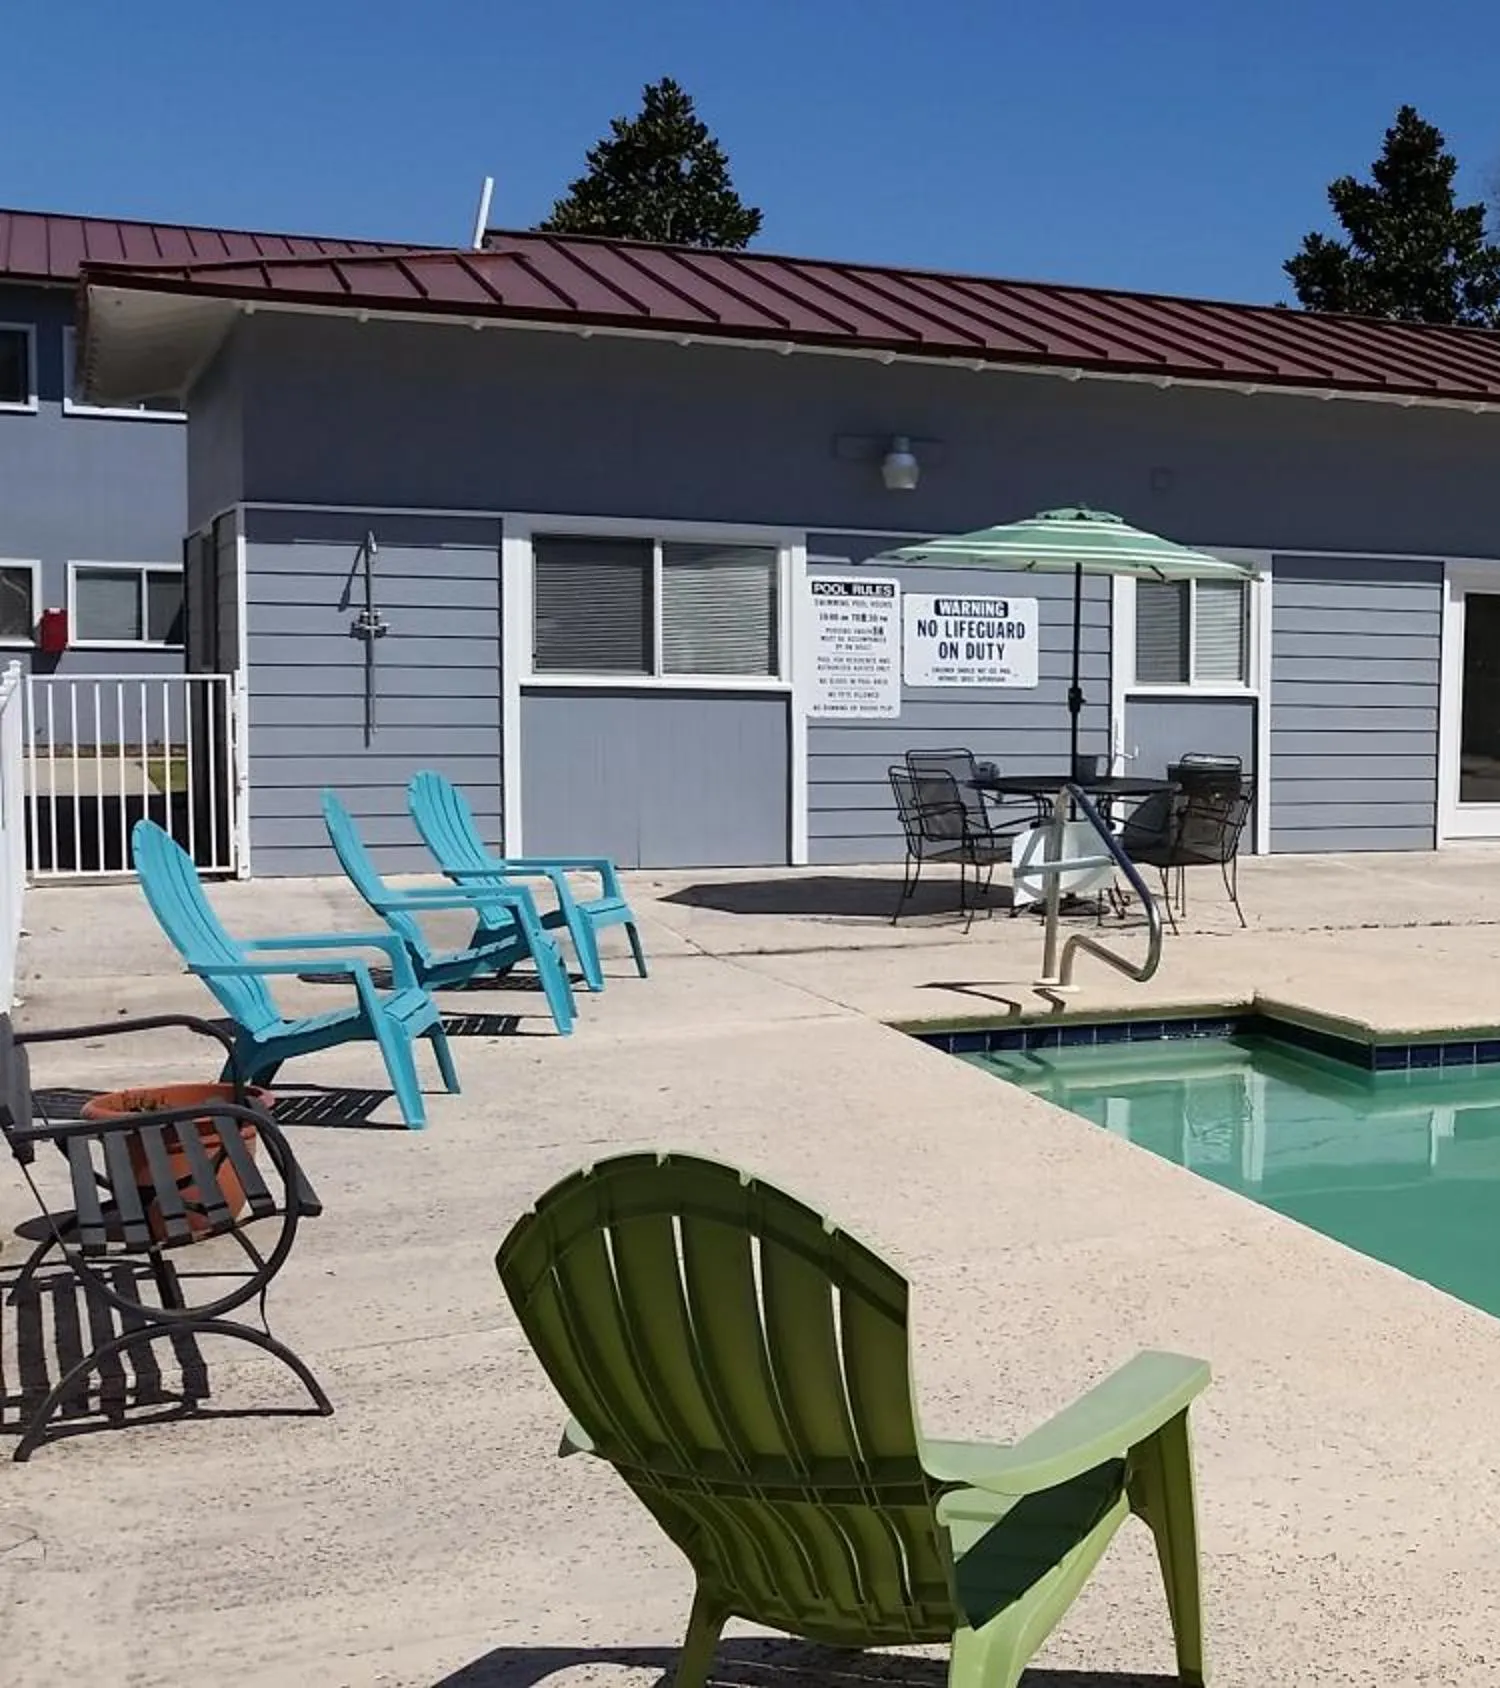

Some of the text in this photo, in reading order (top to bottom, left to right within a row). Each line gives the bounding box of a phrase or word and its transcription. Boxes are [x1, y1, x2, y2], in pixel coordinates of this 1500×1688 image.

[815, 583, 893, 597] POOL RULES
[940, 600, 1006, 616] WARNING
[917, 619, 1026, 639] NO LIFEGUARD
[939, 641, 1005, 660] ON DUTY
